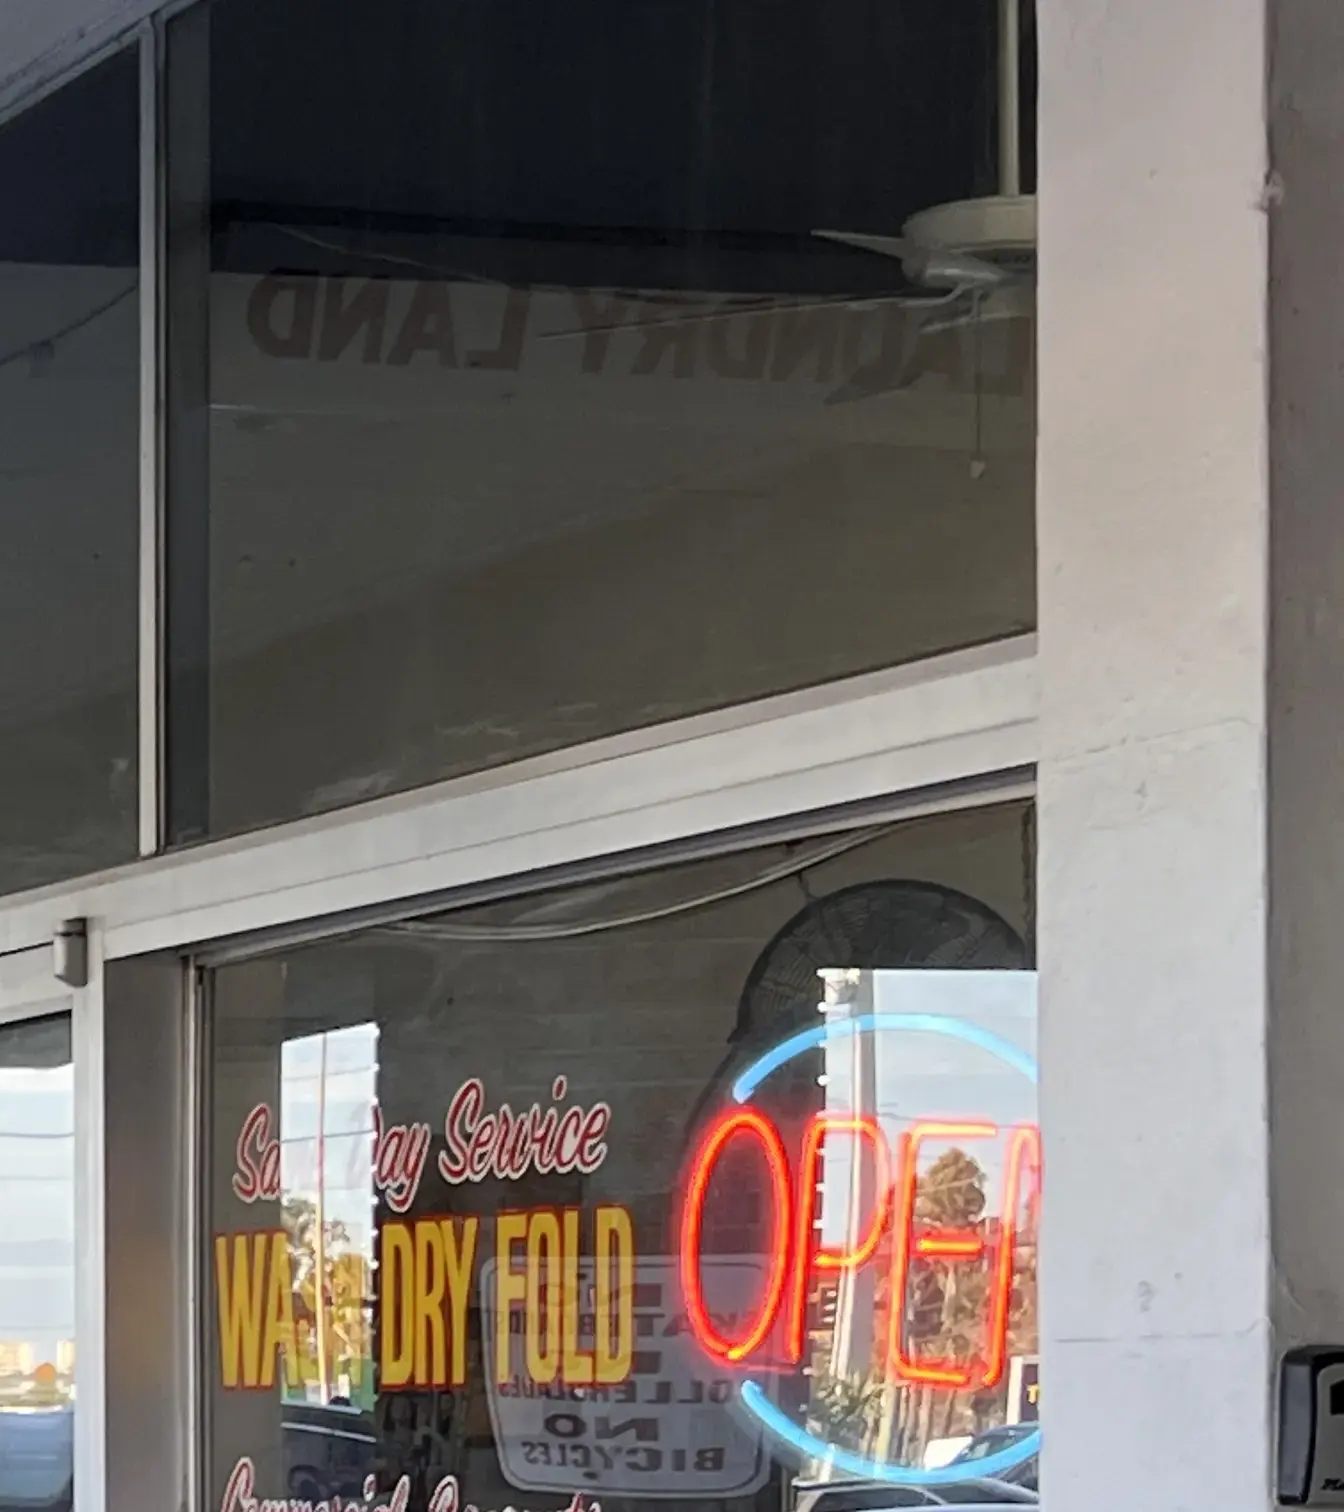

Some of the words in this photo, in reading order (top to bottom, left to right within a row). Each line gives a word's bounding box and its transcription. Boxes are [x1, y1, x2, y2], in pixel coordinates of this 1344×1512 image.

[438, 1074, 612, 1185] Service
[379, 1210, 481, 1392] DRY
[495, 1204, 636, 1391] FOLD
